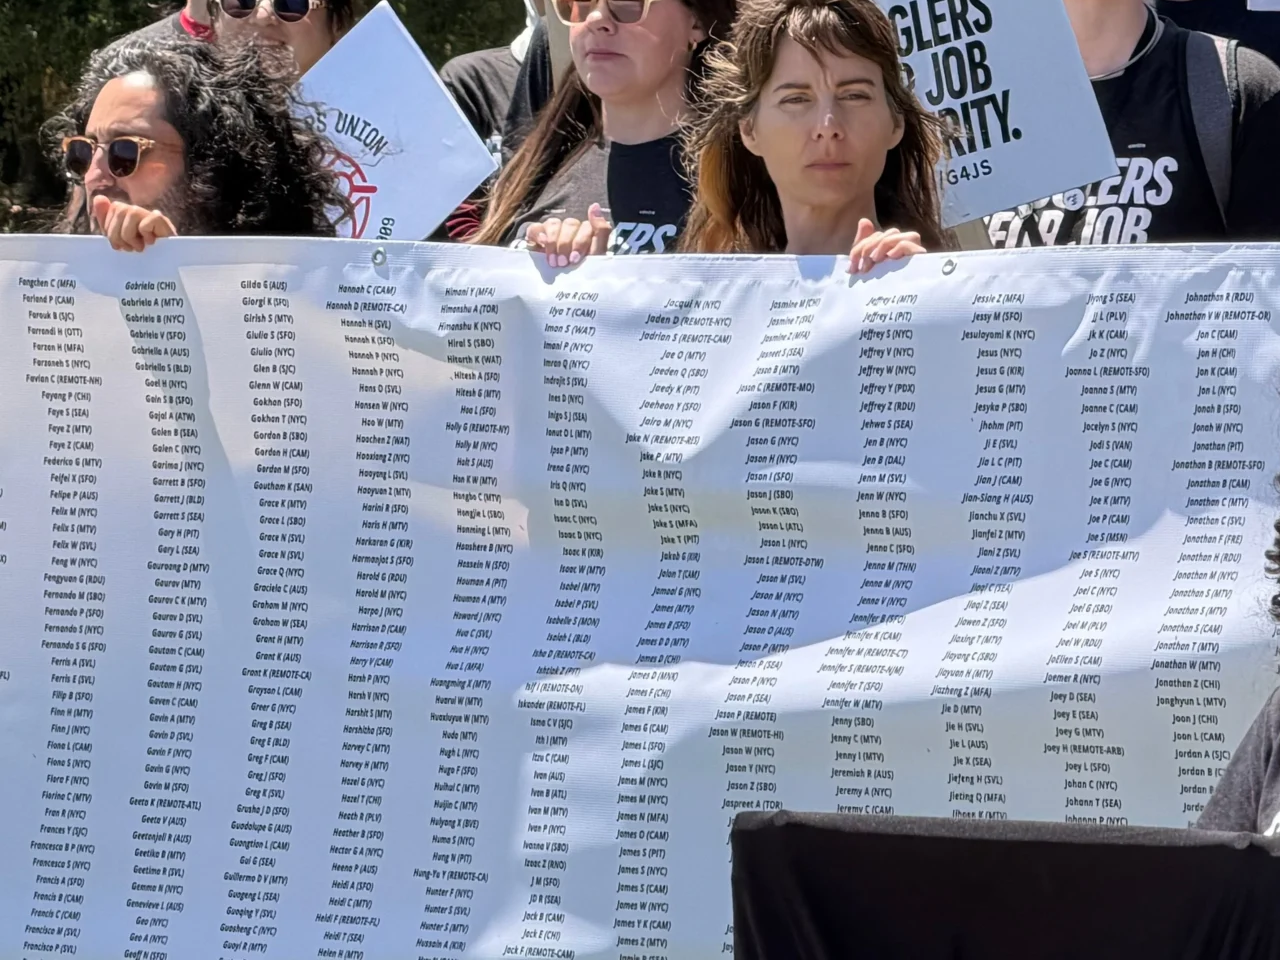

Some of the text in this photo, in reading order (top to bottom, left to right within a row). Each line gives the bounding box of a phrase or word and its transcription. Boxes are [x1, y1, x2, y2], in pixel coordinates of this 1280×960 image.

[925, 40, 993, 106] JOB
[937, 89, 1023, 159] RITY.
[335, 113, 388, 156] UNION
[121, 298, 183, 308] Gabriela A (MTV)
[1184, 292, 1254, 304] Johnathan R (RDU)
[438, 321, 501, 332] Himanshu K (NYC)
[858, 365, 916, 377] Jeffrey W (NYC)
[249, 381, 303, 391] Glenn W (CAM)
[1044, 743, 1124, 757] Joey H (REMOTE-ARB)
